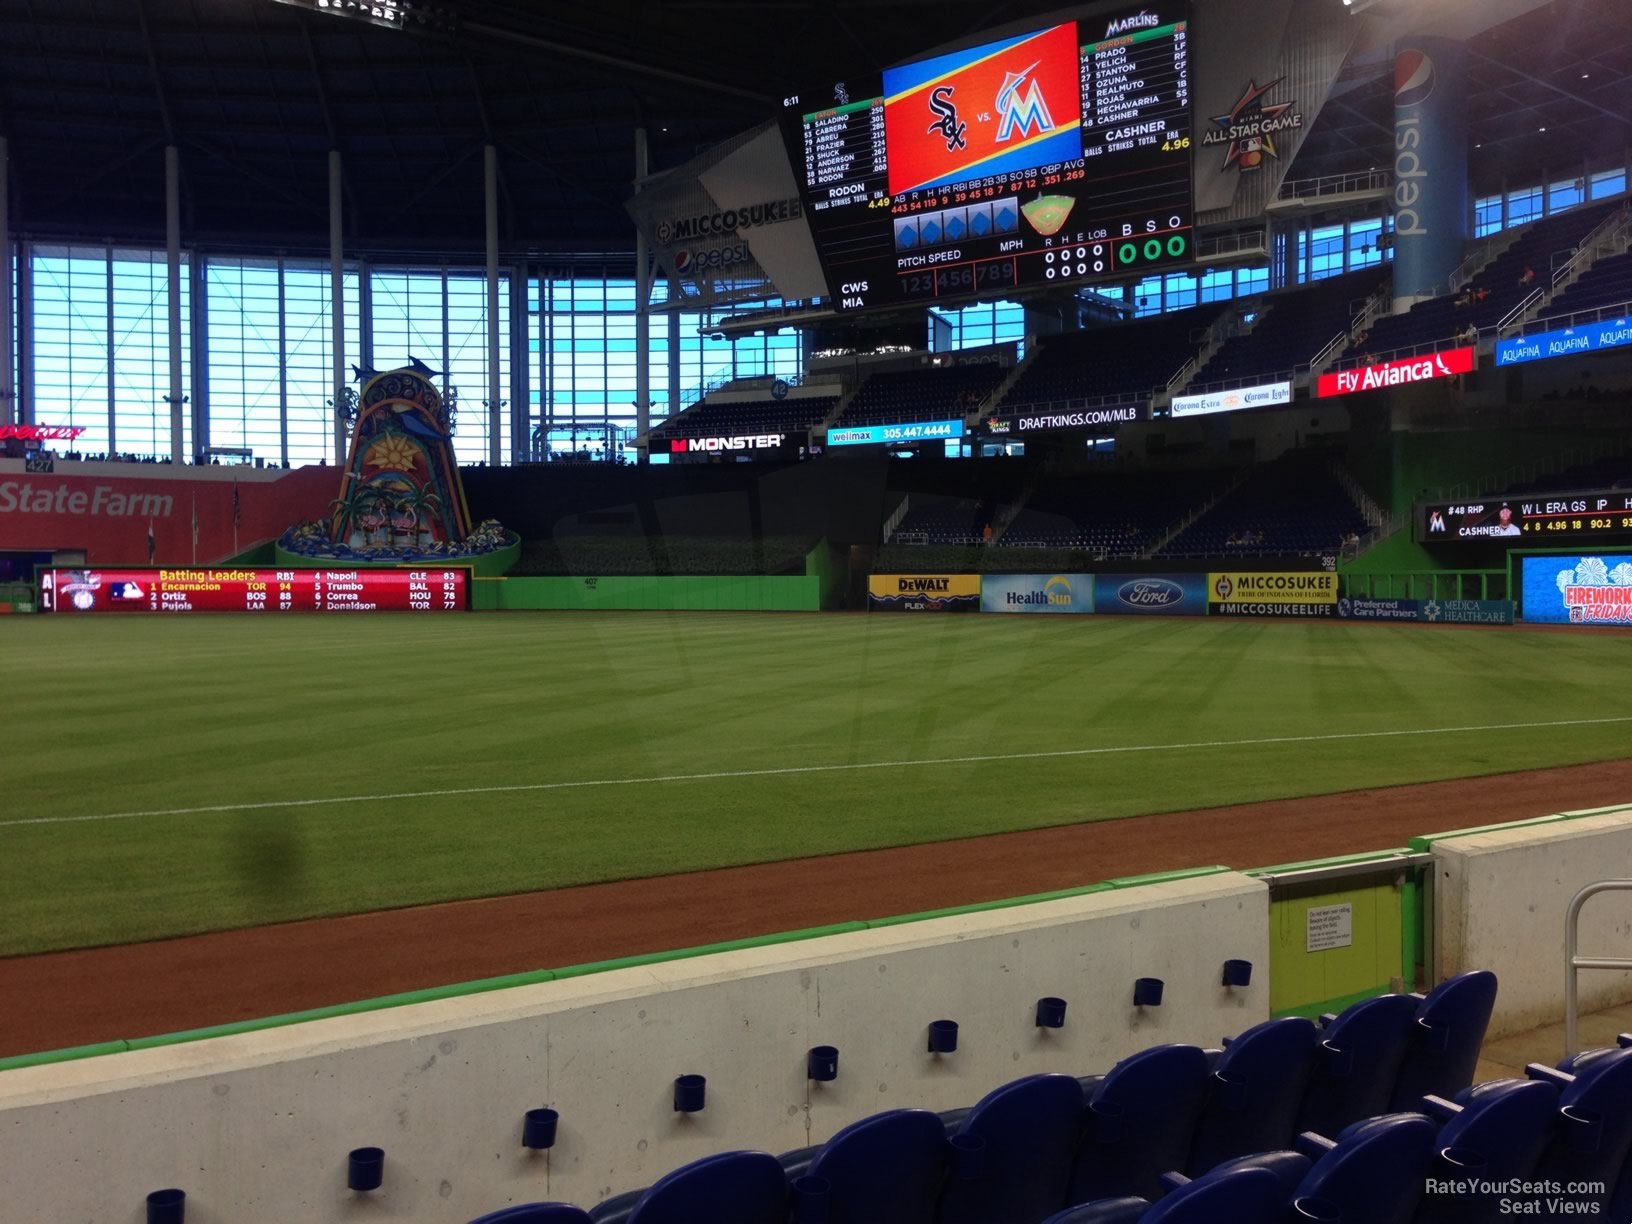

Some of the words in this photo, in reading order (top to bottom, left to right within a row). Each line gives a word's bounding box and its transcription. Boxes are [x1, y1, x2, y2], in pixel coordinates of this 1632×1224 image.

[1105, 11, 1159, 39] MARLINS
[1095, 47, 1126, 60] PRADO
[1174, 33, 1185, 41] 3B
[1096, 56, 1126, 69] YELICH
[1175, 42, 1185, 51] LF
[1096, 64, 1136, 78] STANTON
[1174, 52, 1186, 60] RF
[1096, 76, 1128, 88] OZUNA
[1174, 61, 1186, 69] CF
[1097, 80, 1144, 97] REALMUTO
[784, 96, 799, 107] 6:11
[1097, 94, 1125, 106] ROJAS
[1097, 96, 1159, 115] HECHAVARRIA
[815, 115, 849, 127] SALADINO
[1097, 110, 1138, 124] CASHNER
[815, 124, 847, 136] CABRERA
[1106, 121, 1166, 141] CASHNER
[1229, 123, 1258, 139] STAR
[1261, 115, 1301, 132] GAME
[816, 134, 839, 144] ABREU
[1085, 146, 1102, 157] BALLS
[1108, 141, 1134, 152] STRIKES
[1138, 136, 1157, 145] TOTAL
[1167, 131, 1178, 140] ERA
[1162, 138, 1190, 151] 4.96
[817, 141, 845, 152] FRAZIER
[817, 150, 840, 160] SHUCK
[818, 155, 855, 168] ANDERSON
[818, 164, 849, 176] NARVAEZ
[819, 173, 843, 183] RODON
[894, 194, 906, 204] AB
[939, 186, 951, 195] HR
[953, 183, 968, 192] RBI
[969, 180, 981, 189] BB
[983, 178, 994, 187] 2B
[996, 175, 1007, 184] 3B
[1009, 172, 1023, 182] SO
[1025, 169, 1037, 178] SB
[1041, 164, 1061, 175] OBP
[1064, 160, 1084, 170] AVG
[1395, 118, 1427, 235] pepsi
[830, 183, 865, 198] RODON
[891, 204, 908, 214] 443
[910, 202, 922, 210] 54
[924, 199, 937, 208] 119
[955, 193, 966, 202] 39
[969, 190, 981, 199] 45
[984, 188, 993, 196] 18
[1011, 182, 1022, 191] 87
[1026, 180, 1036, 188] 12
[1042, 175, 1060, 185] .351
[1064, 170, 1085, 181] .269
[868, 198, 890, 208] 4.49
[674, 198, 802, 239] MICCOSUKEE
[1123, 224, 1132, 236] B
[1147, 220, 1156, 232] S
[1169, 216, 1180, 228] O
[1088, 229, 1107, 240] LOB
[1000, 240, 1023, 251] MPH
[695, 239, 749, 272] pepsi
[898, 254, 926, 268] PITCH
[928, 250, 961, 262] SPEED
[842, 281, 868, 294] CWS
[842, 297, 864, 309] MIA
[1549, 336, 1589, 355] AQUAFINA
[1502, 345, 1540, 362] AQUAFINA
[1337, 372, 1358, 392] Fly
[1362, 360, 1433, 389] Avianca
[773, 385, 786, 395] 42
[1244, 391, 1269, 403] Corona
[1174, 402, 1199, 412] Corona
[1019, 408, 1136, 431] DRAFTKINGS.COM/MLB
[833, 431, 871, 441] wellmax
[883, 425, 950, 439] 305.447.4444
[1468, 505, 1484, 514] RHP
[1522, 504, 1533, 514] W
[1535, 504, 1542, 514] L
[1546, 502, 1567, 513] ERA
[1571, 501, 1586, 512] GS
[1597, 500, 1608, 510] IP
[1459, 526, 1500, 536] CASHNER
[1523, 523, 1529, 531] 4
[1547, 521, 1566, 530] 4.96
[1573, 521, 1581, 529] 18
[1591, 519, 1611, 528] 90.2
[1322, 557, 1335, 566] 392
[159, 570, 205, 583] Batting
[209, 570, 256, 581] Leaders
[277, 572, 294, 581] RBI
[327, 572, 357, 582] Napoli
[1238, 577, 1331, 589] MICCOSUKEE
[162, 592, 186, 600] Ortiz
[1130, 582, 1169, 604] Ford
[162, 602, 192, 611] Pujols
[1220, 603, 1330, 615] #MICCOSUKEELIFE
[1354, 600, 1398, 610] Preferred
[1444, 601, 1479, 611] MEDICA
[1354, 608, 1371, 617] Care
[1373, 609, 1417, 618] Partners
[1444, 612, 1505, 622] HEALTHCARE
